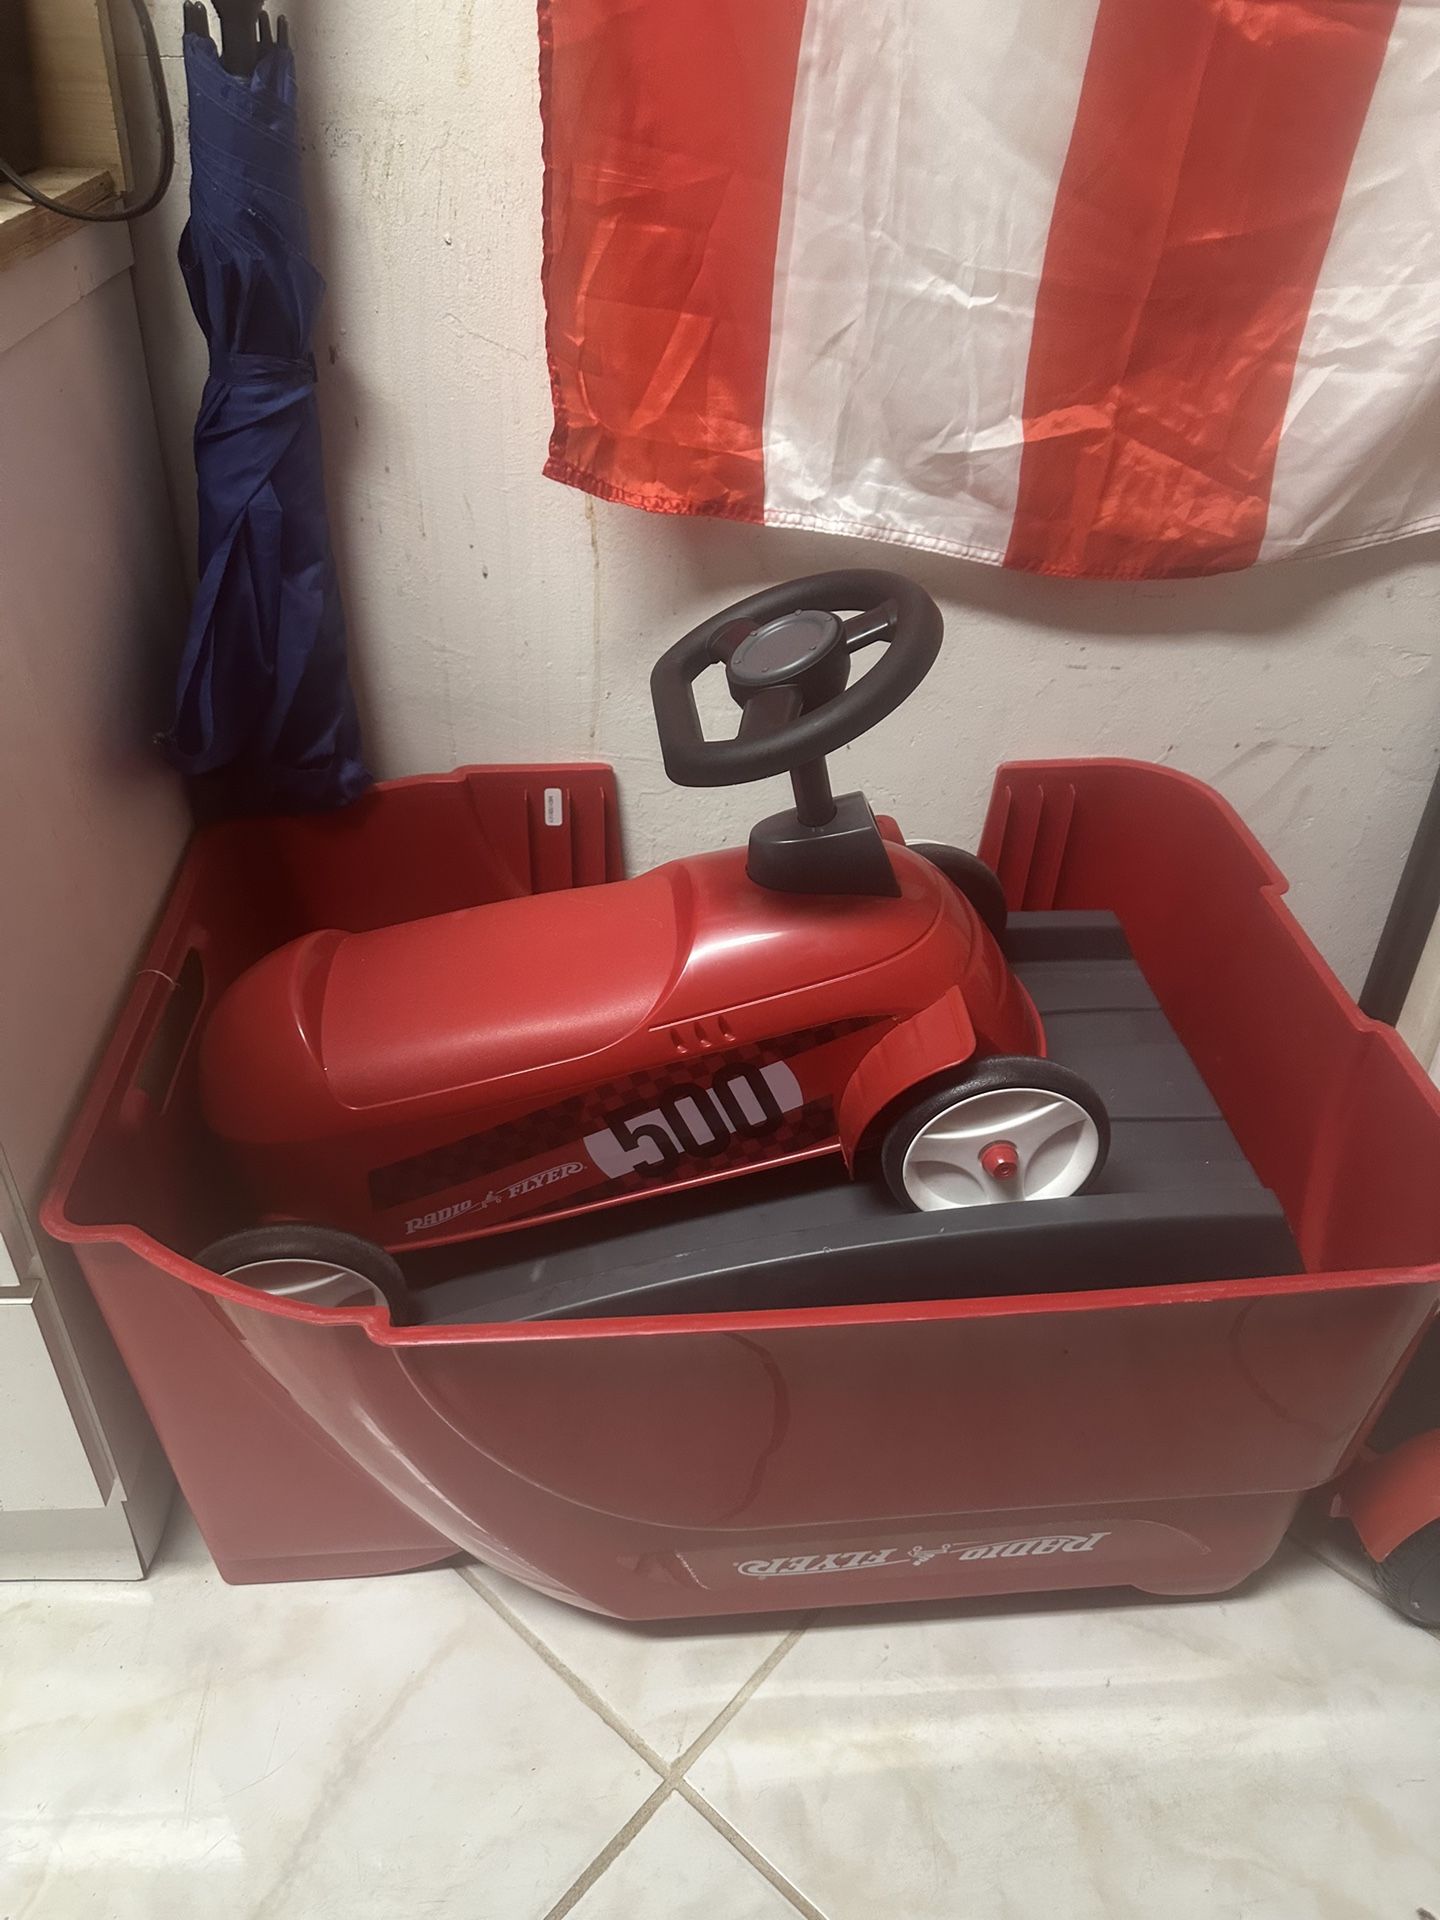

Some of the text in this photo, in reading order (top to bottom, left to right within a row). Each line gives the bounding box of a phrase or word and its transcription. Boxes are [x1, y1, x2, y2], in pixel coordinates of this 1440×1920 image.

[604, 1061, 784, 1178] 500
[405, 1161, 584, 1235] RADIO FLYER
[736, 1531, 1112, 1578] RADIO FLYER
